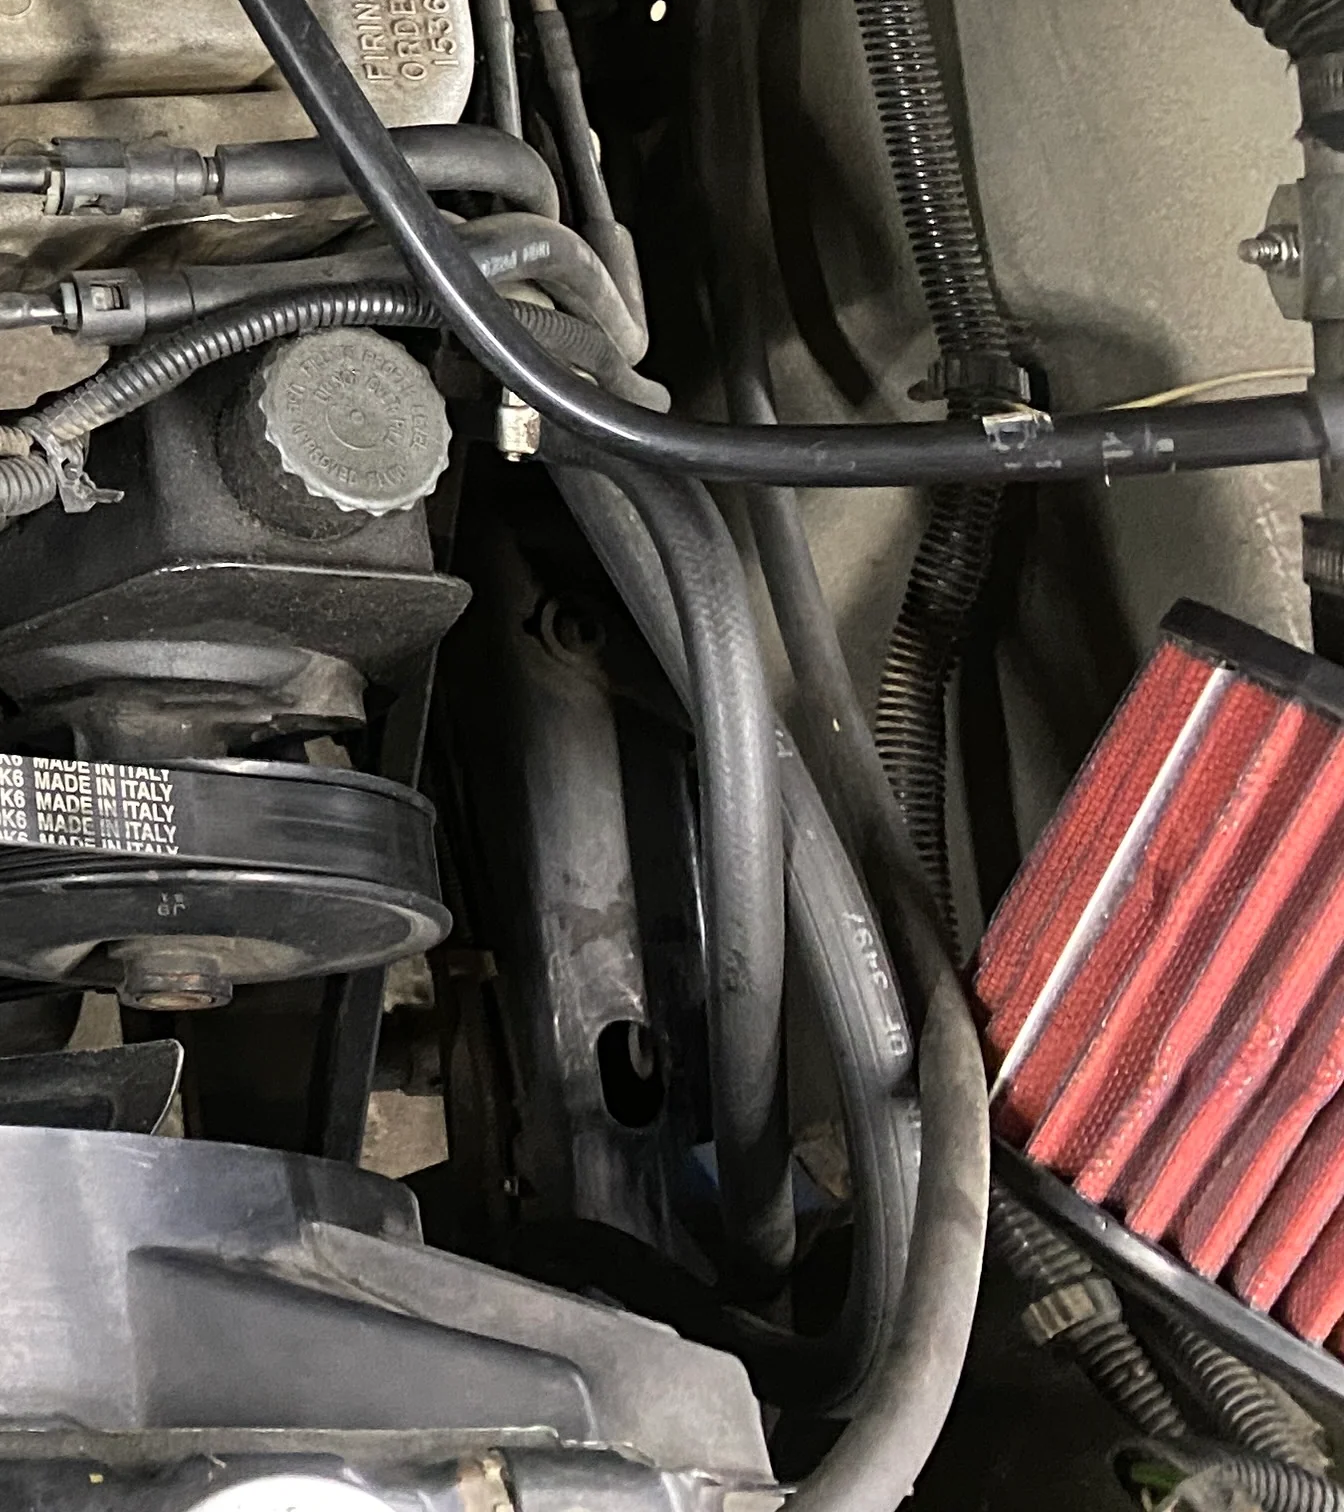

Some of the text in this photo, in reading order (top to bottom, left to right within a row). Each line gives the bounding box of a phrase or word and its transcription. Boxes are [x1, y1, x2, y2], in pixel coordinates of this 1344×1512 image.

[34, 771, 92, 795] MADE
[95, 777, 116, 797] IN
[120, 779, 174, 803] ITALY
[35, 791, 94, 815] MADE
[98, 798, 118, 818] IN
[122, 800, 175, 823] ITALY
[37, 812, 96, 836] MADE
[100, 818, 120, 838] IN
[124, 820, 177, 844] ITALY
